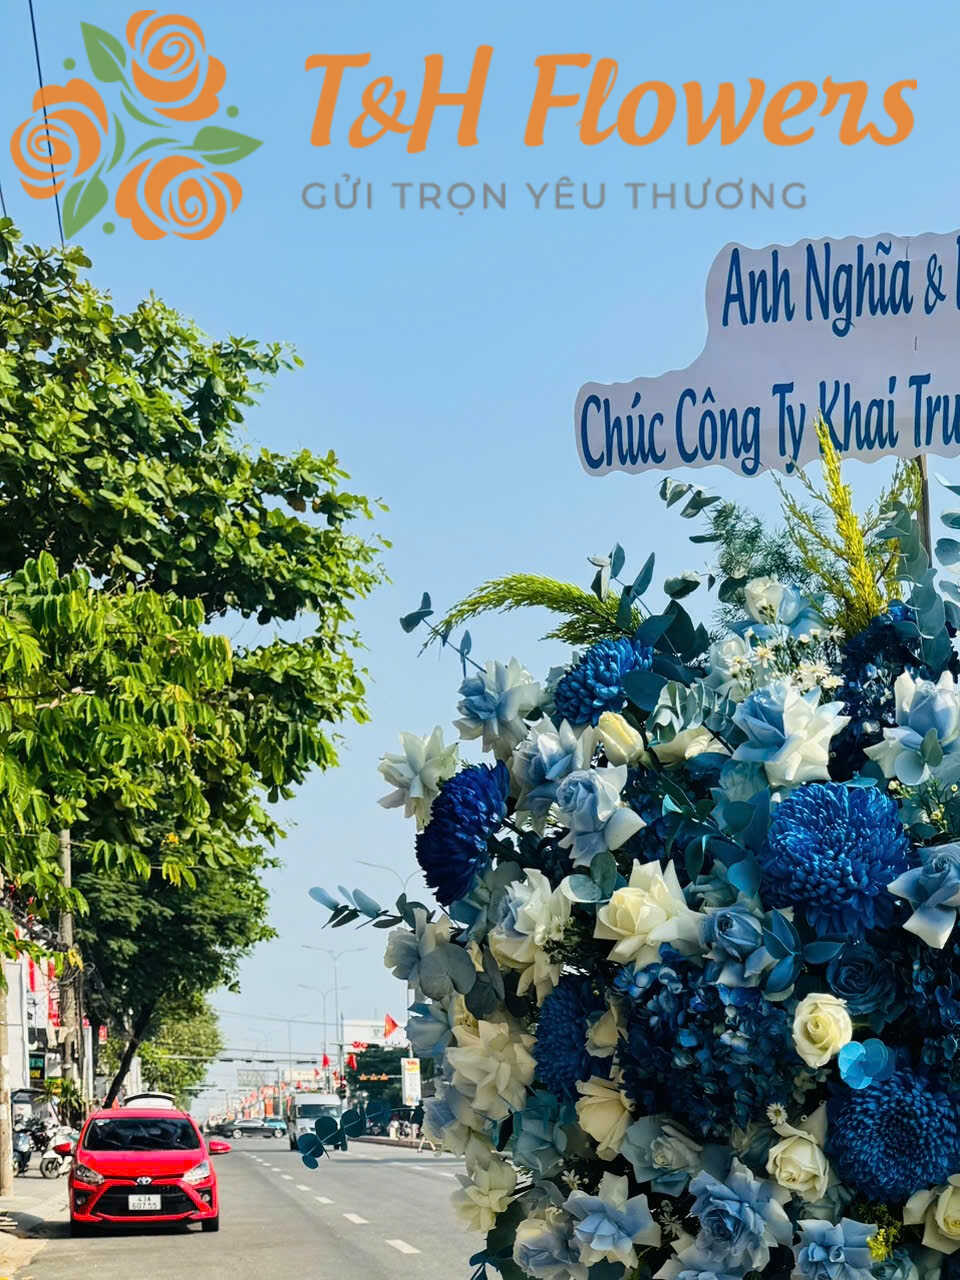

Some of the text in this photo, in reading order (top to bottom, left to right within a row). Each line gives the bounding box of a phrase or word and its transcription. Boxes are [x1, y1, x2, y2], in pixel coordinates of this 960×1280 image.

[721, 247, 796, 328] Anh
[805, 239, 914, 338] Nghĩa
[923, 253, 947, 316] &
[580, 391, 668, 470] Chúc
[675, 386, 763, 476] Công
[771, 381, 807, 474] Ty
[818, 375, 899, 455] Khai
